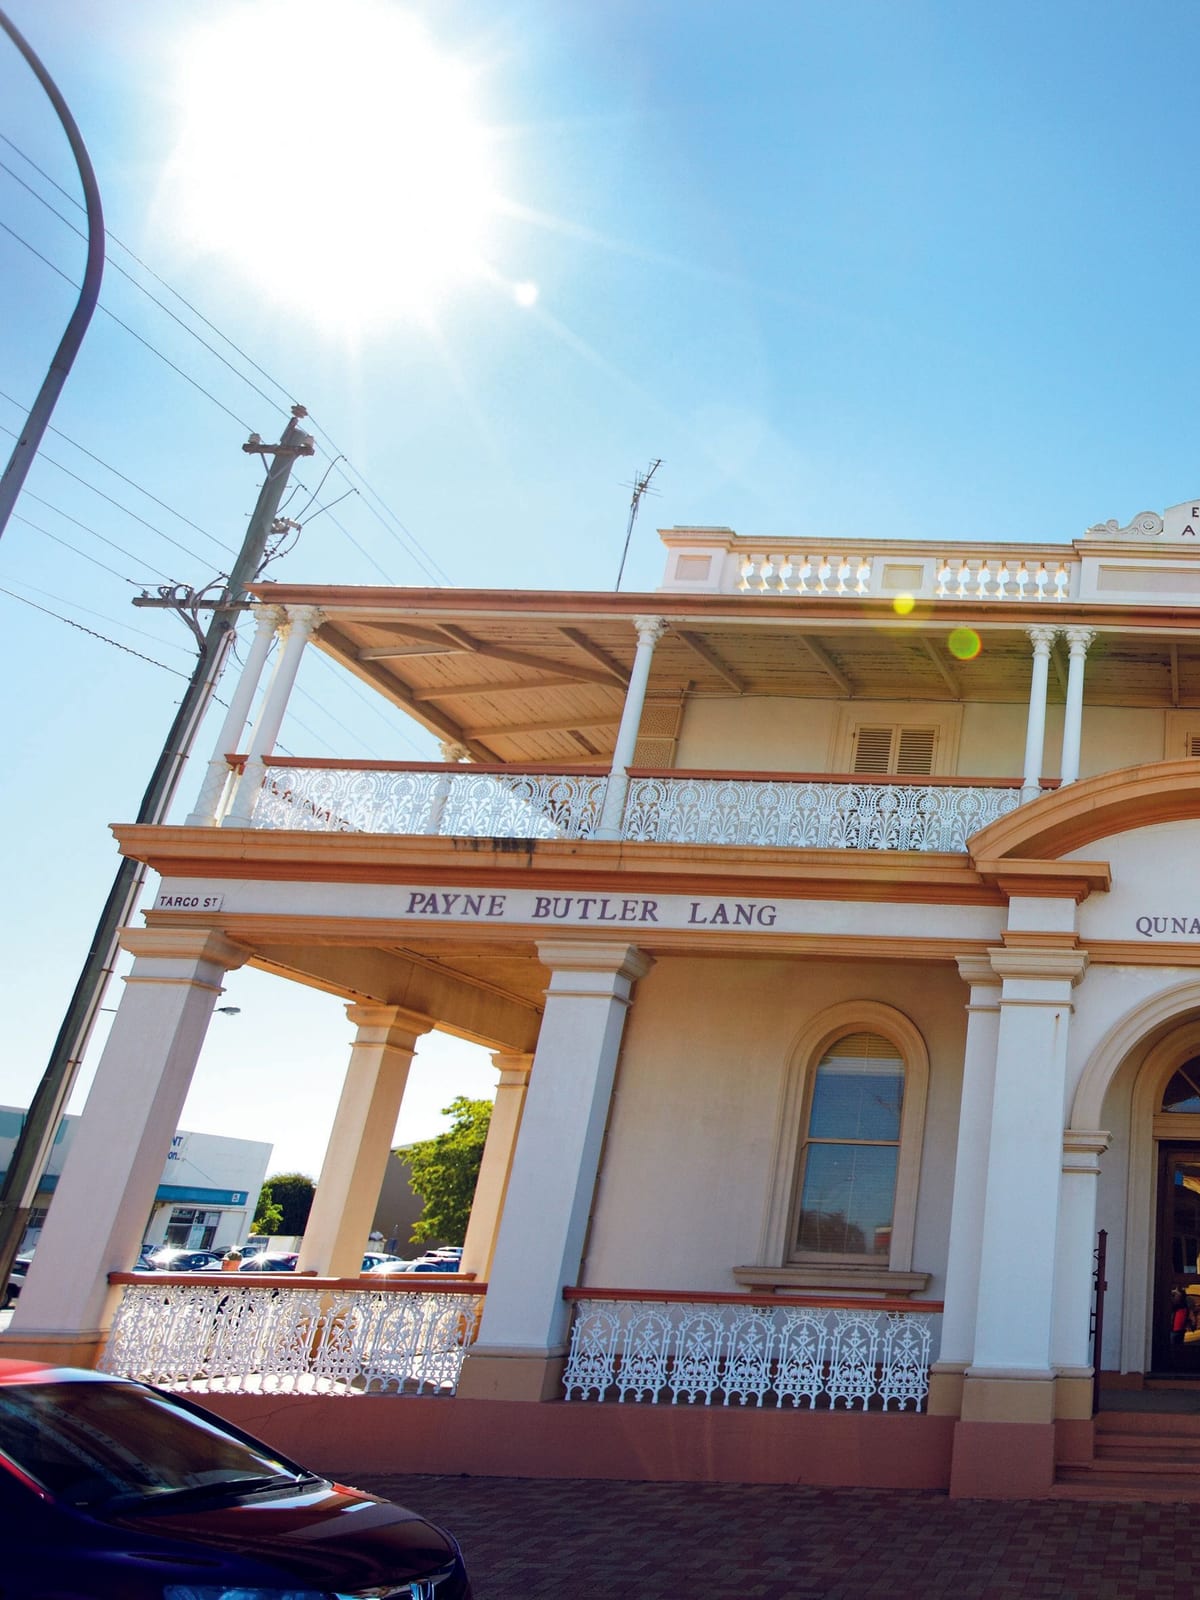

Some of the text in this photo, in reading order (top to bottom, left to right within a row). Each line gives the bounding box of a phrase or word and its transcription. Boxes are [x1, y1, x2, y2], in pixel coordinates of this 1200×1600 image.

[1182, 525, 1195, 536] A
[203, 897, 218, 907] ST
[405, 892, 777, 926] PAYNE BUTLER LANG
